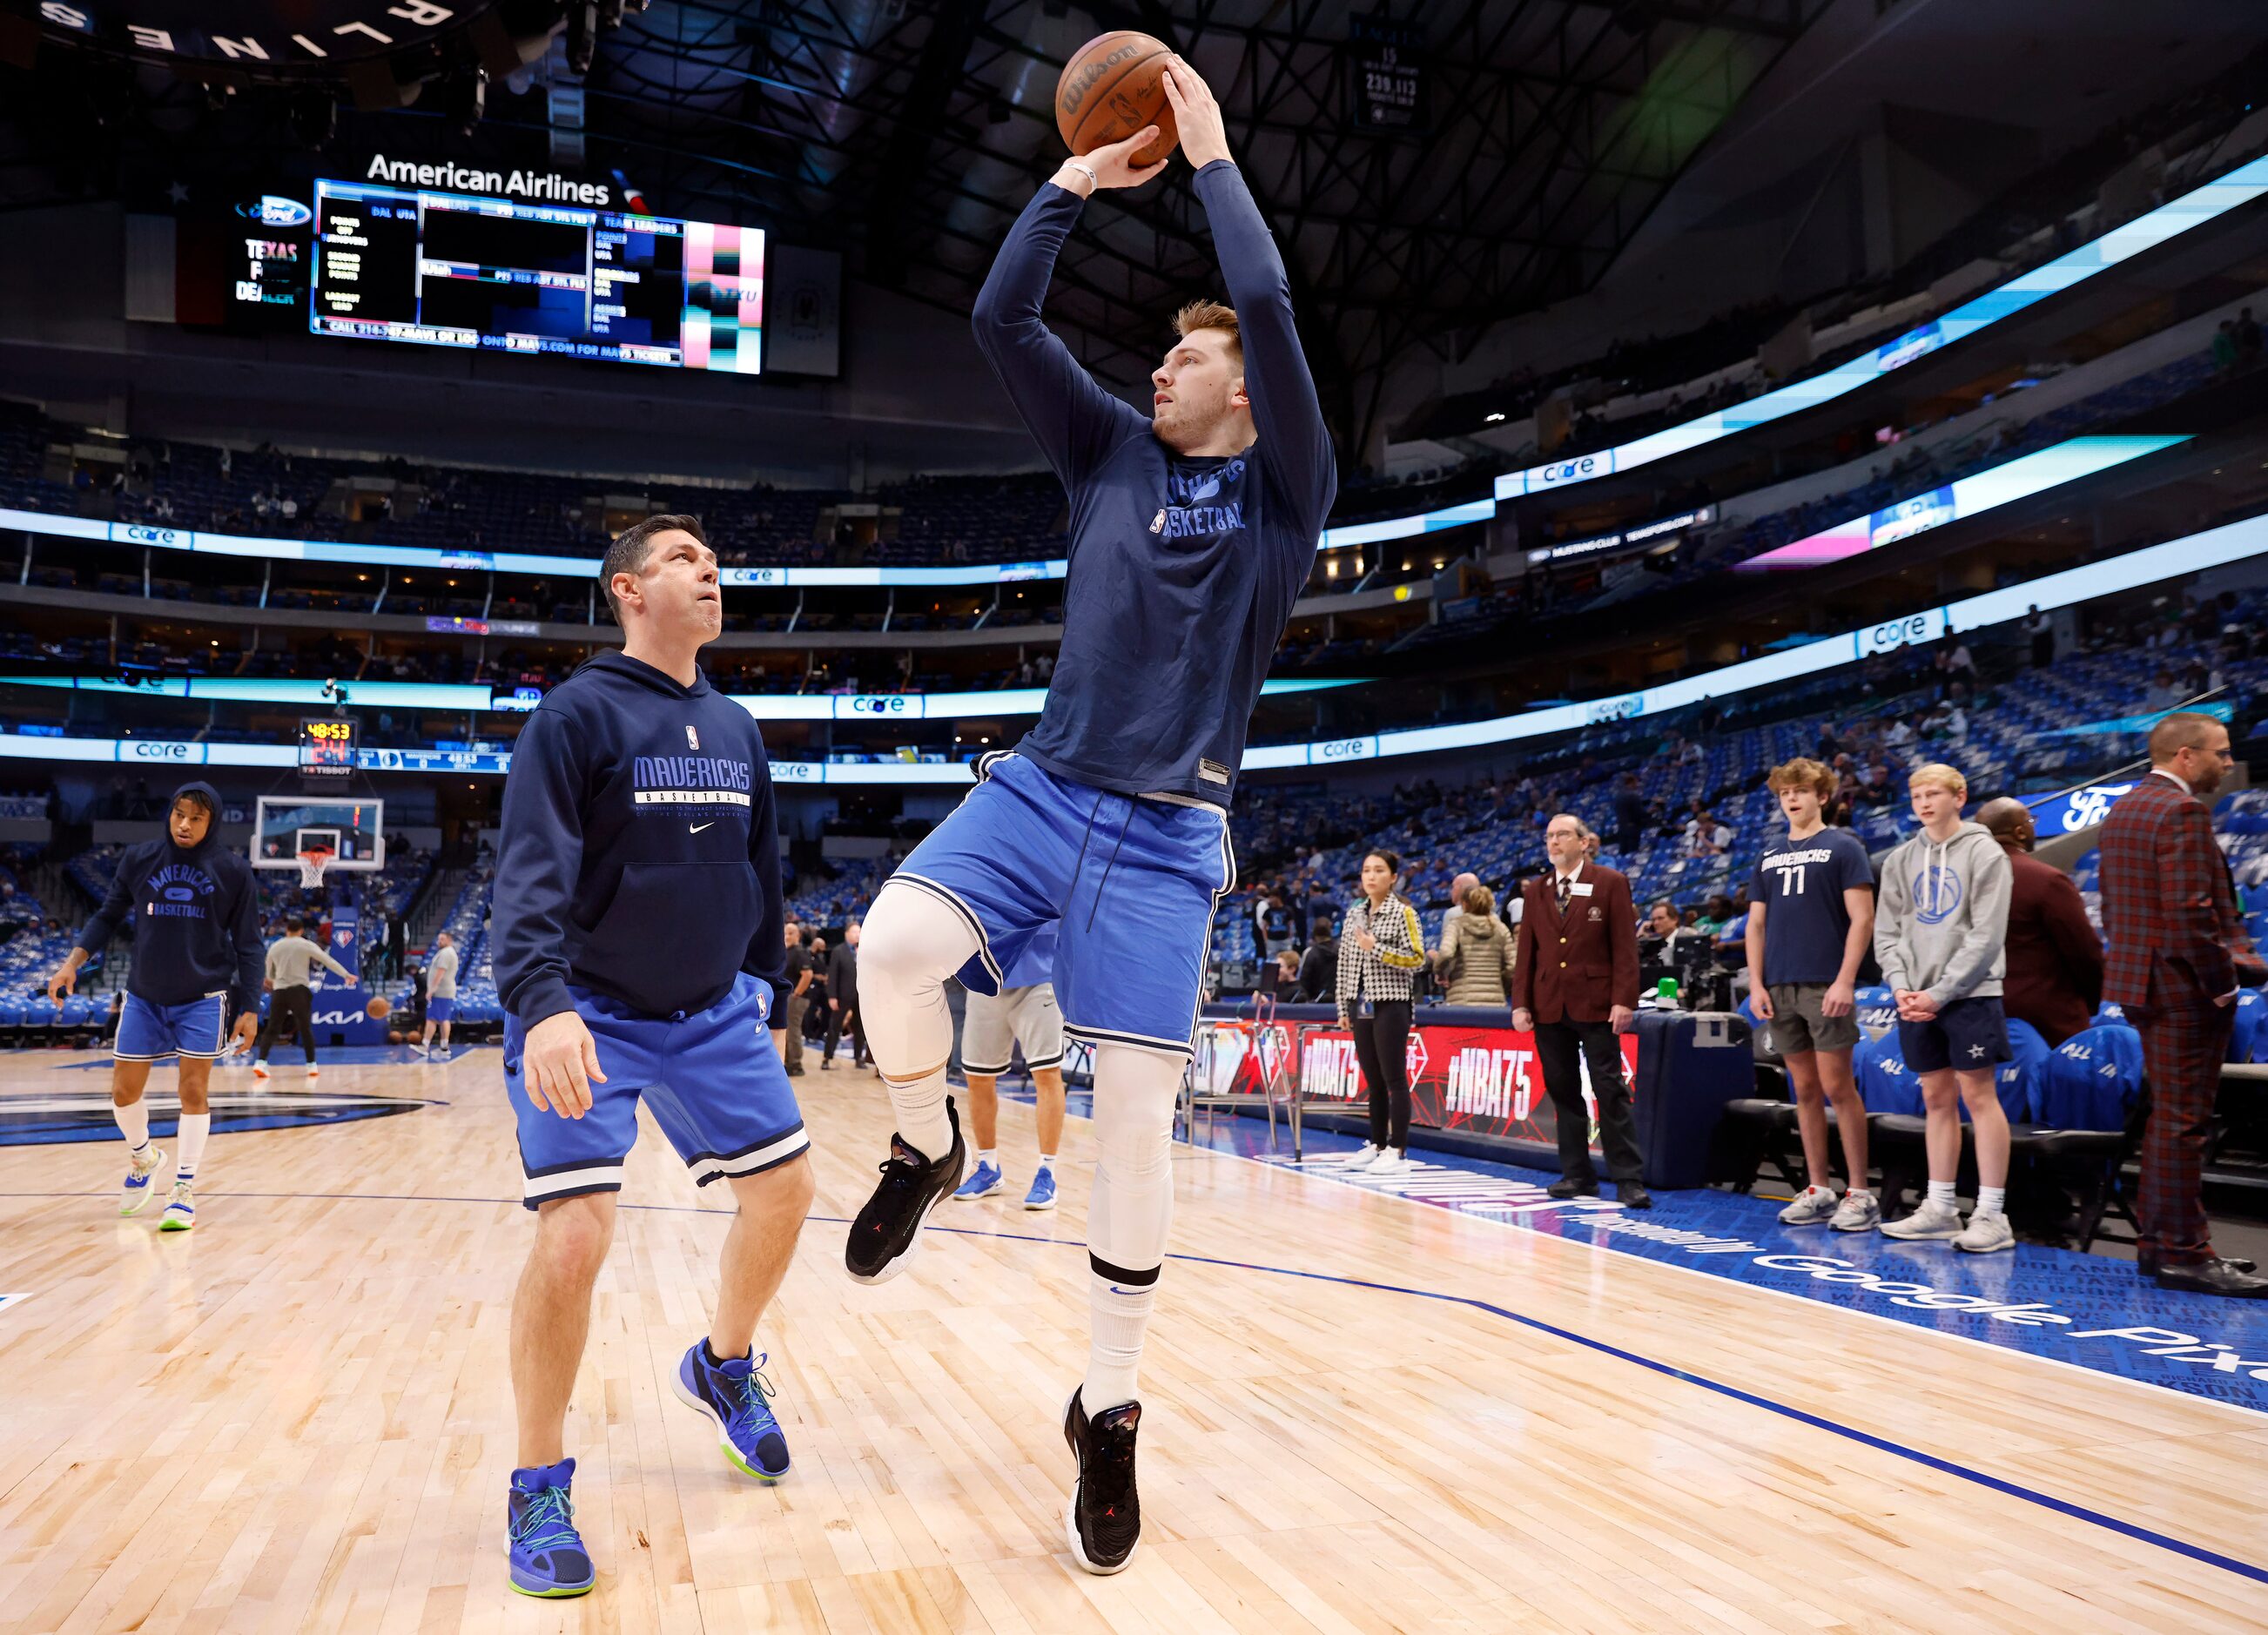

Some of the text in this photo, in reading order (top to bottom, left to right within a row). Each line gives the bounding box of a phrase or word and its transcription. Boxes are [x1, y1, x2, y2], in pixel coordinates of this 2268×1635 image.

[1062, 44, 1139, 115] Wilson
[367, 154, 609, 205] American Airlines
[372, 205, 416, 220] DAL UTA
[604, 217, 677, 234] TEAM LEADERS
[246, 239, 298, 261] TEXAS
[329, 320, 355, 333] CALL
[438, 331, 454, 342] OR
[482, 335, 515, 348] ONTO
[517, 337, 575, 353] MAVS.COM
[577, 344, 598, 356] FOR
[1544, 458, 1594, 481] core
[128, 527, 175, 543] core
[735, 569, 773, 582] core
[1874, 616, 1925, 645] core
[853, 696, 905, 713] core
[308, 723, 350, 740] 48:53
[137, 743, 187, 757] core
[313, 738, 345, 764] 24
[1323, 738, 1363, 757] core
[448, 754, 477, 764] 48:53
[317, 766, 352, 776] TISSOT
[634, 757, 750, 791] MAVERICKS
[646, 792, 745, 804] BASKETBALL
[1761, 849, 1832, 872] MAVERICKS
[147, 864, 215, 896] MAVERICKS
[1776, 865, 1806, 897] 77
[154, 903, 206, 918] BASKETBALL
[312, 1010, 364, 1025] KIA
[2061, 1042, 2092, 1060] ALL
[1301, 1038, 1360, 1098] #NBA75
[1880, 1058, 1905, 1075] ALL
[1446, 1047, 1532, 1121] #NBA75
[1753, 1255, 2268, 1383] Google Pix
